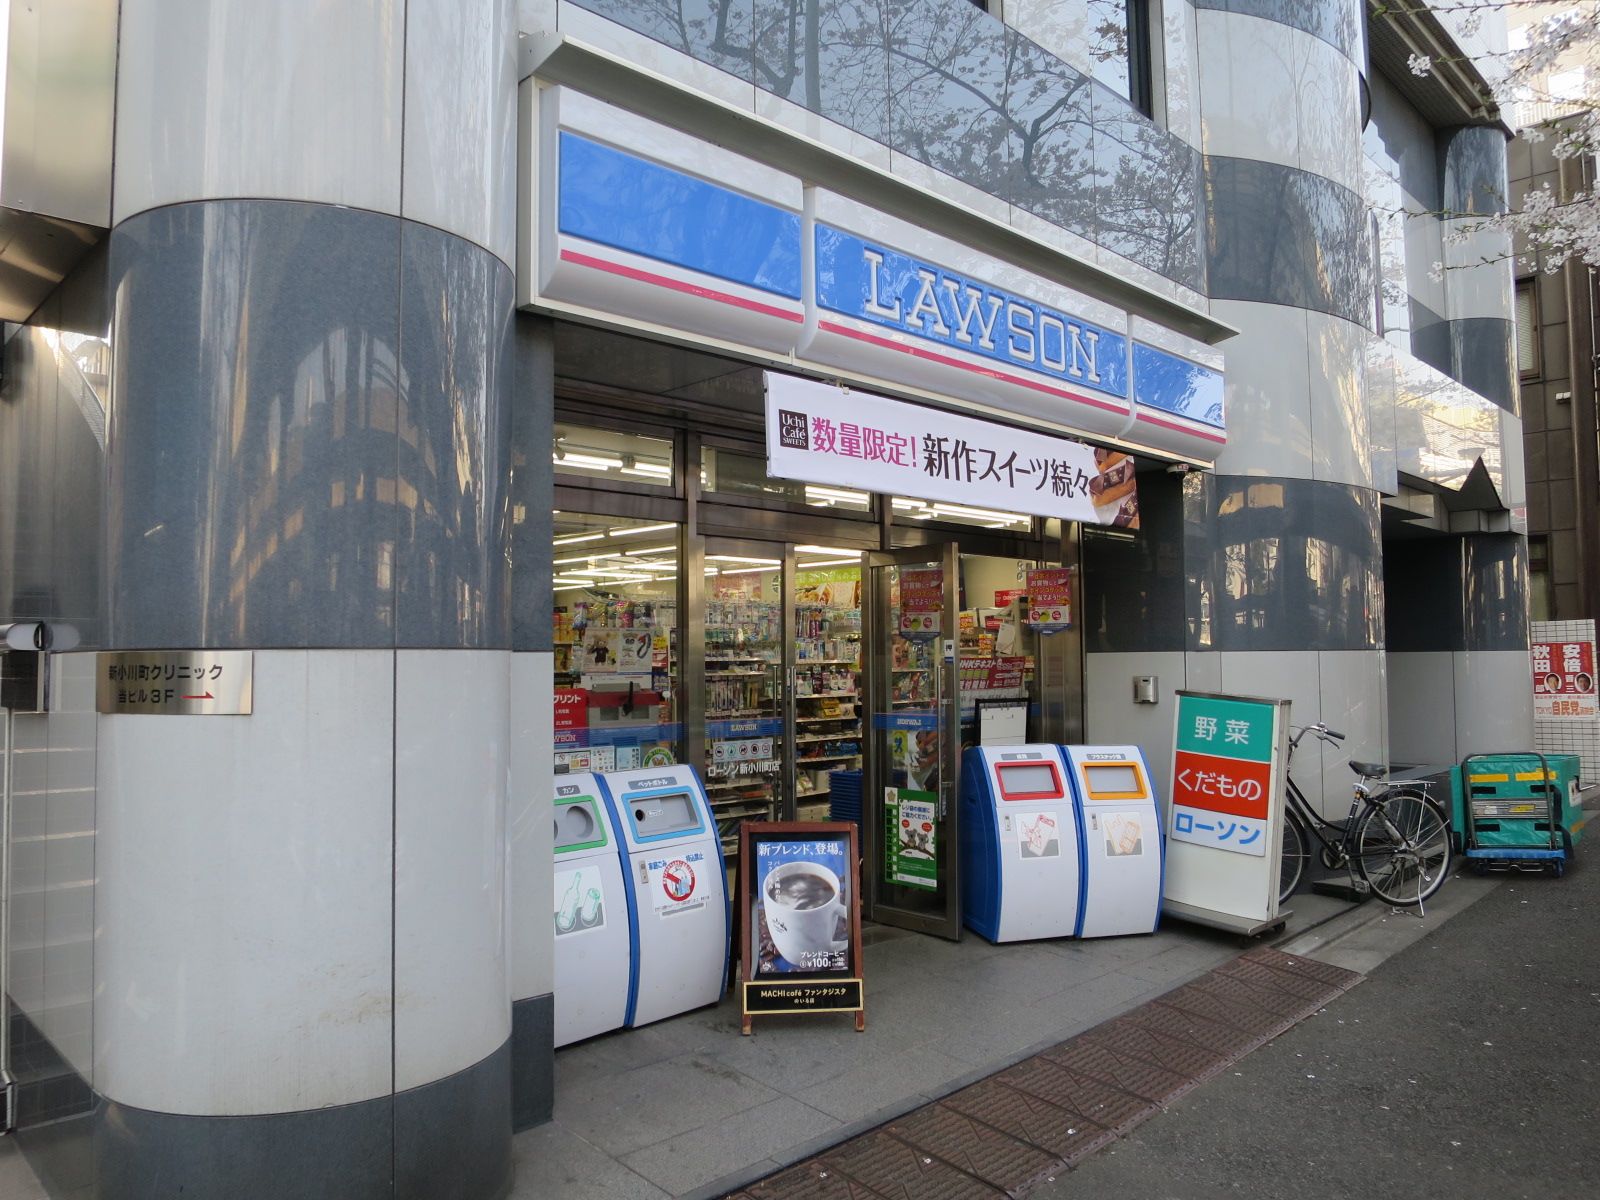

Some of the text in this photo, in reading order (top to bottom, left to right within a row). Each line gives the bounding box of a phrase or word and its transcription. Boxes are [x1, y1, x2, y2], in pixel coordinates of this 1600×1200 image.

[863, 249, 1100, 383] LAWSON
[781, 413, 805, 427] Uchi
[782, 426, 806, 440] Café
[782, 437, 806, 447] SWEETS
[812, 416, 1089, 498] 数量限定! 新作スイーツ続々
[109, 664, 223, 681] 新小川町クリニック
[731, 723, 757, 732] LAWSON
[1194, 716, 1250, 745] 野菜
[553, 734, 576, 743] WSON
[638, 779, 668, 787] ペットボトル
[1177, 768, 1262, 801] くだもの
[1175, 813, 1260, 845] ローソン
[759, 843, 843, 856] 新ブレンド、登場。
[804, 987, 847, 997] ファンタジスタ
